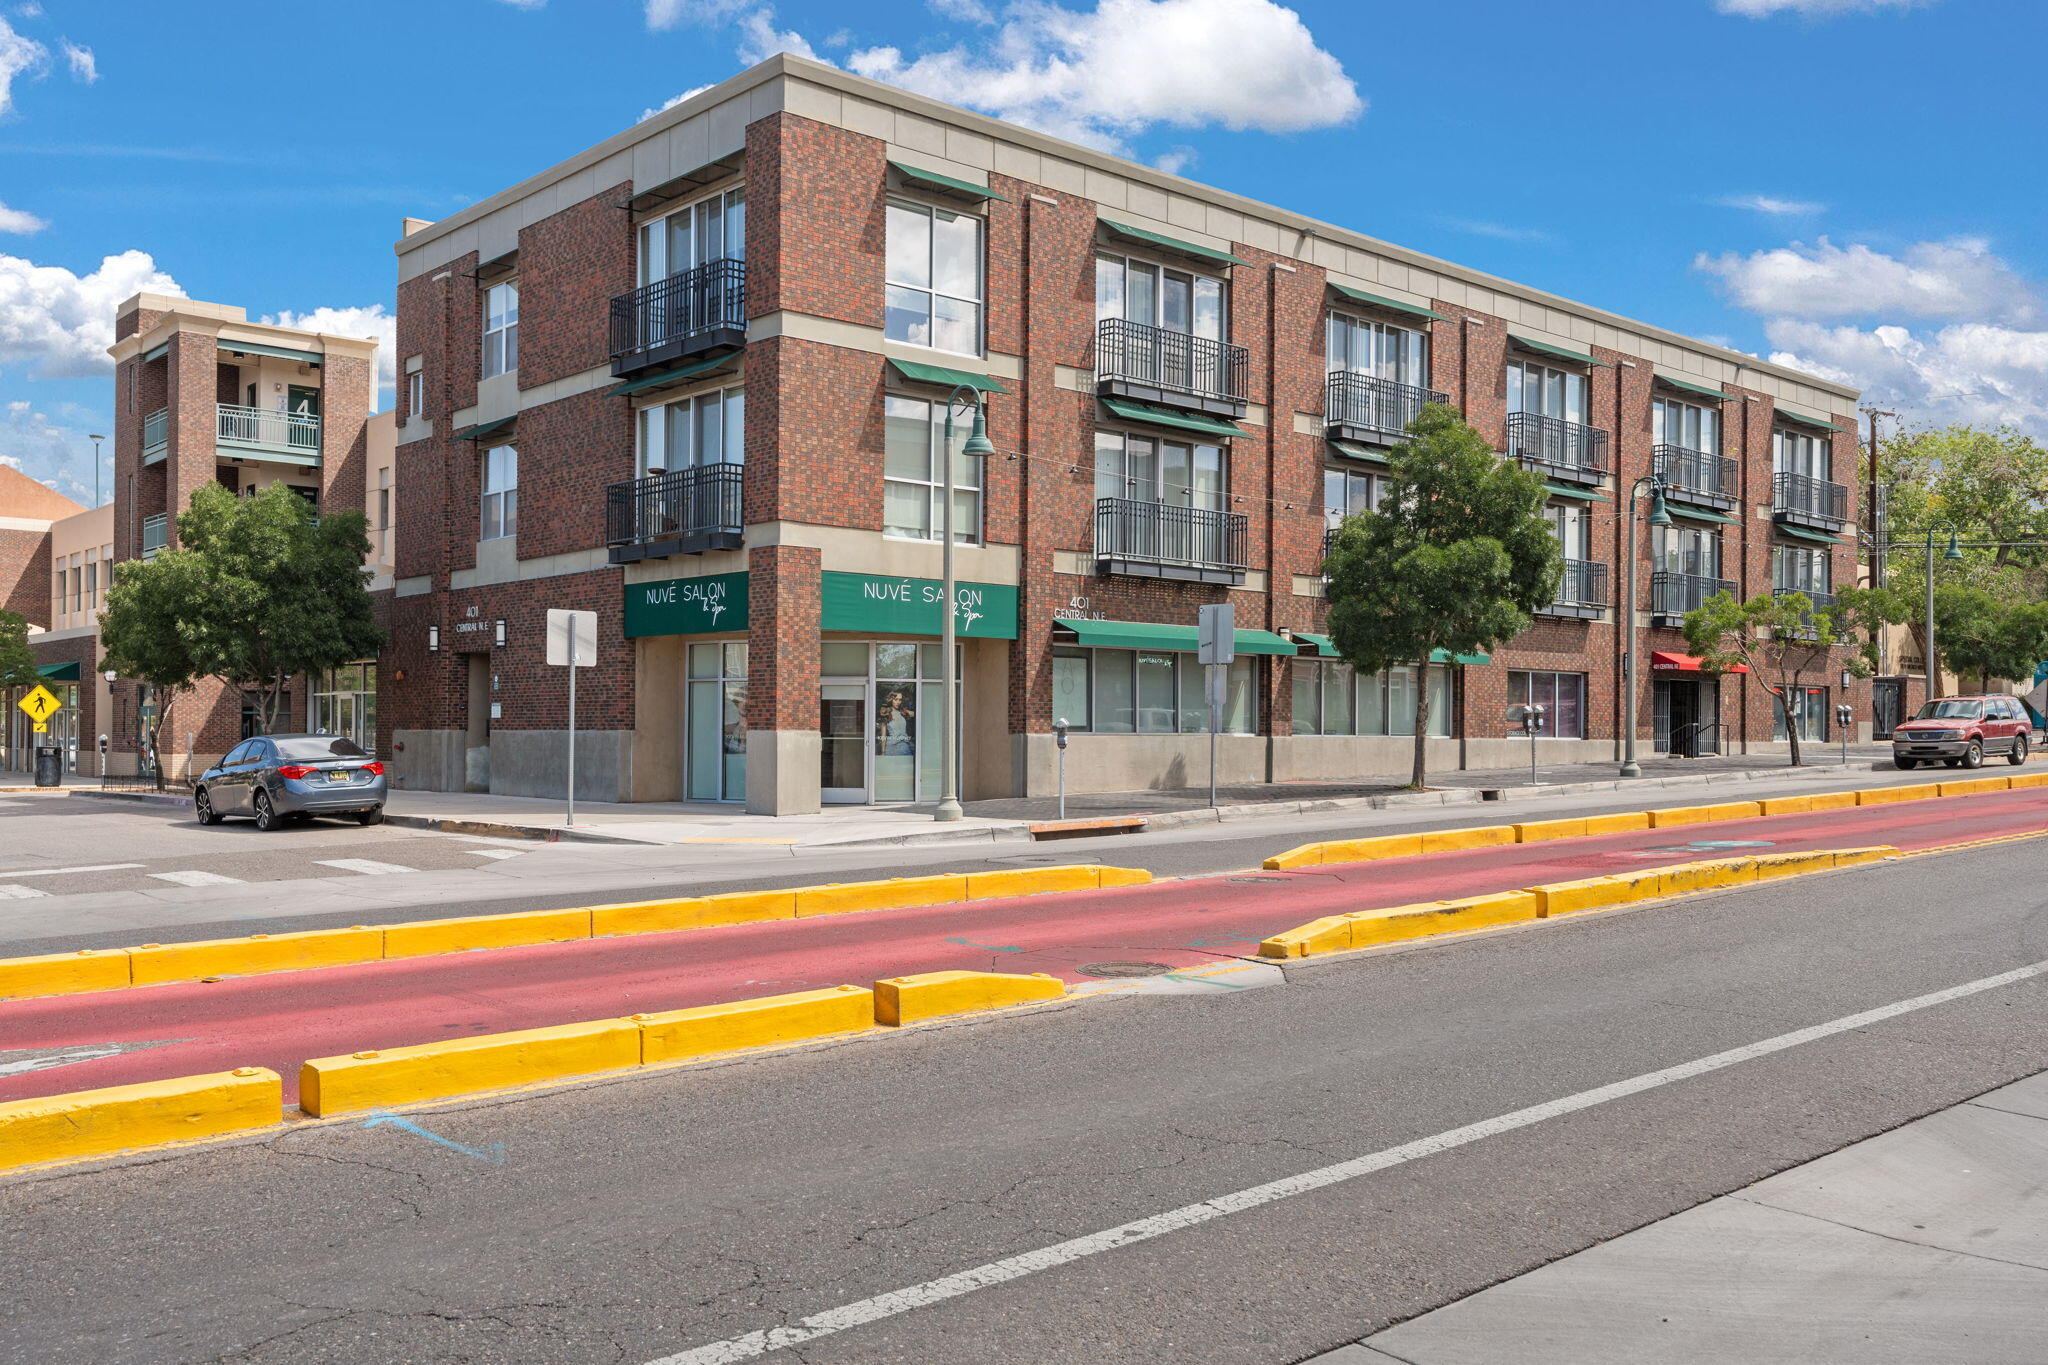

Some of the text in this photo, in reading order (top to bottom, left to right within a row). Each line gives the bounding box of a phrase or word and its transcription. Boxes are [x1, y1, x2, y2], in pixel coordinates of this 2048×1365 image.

[646, 581, 726, 605] NUVÉ SALON
[863, 579, 982, 606] NUVÉ SAON
[1070, 597, 1089, 611] 401
[466, 605, 479, 617] 401
[702, 595, 727, 627] & Spa
[952, 601, 984, 632] & Spa
[1054, 608, 1089, 620] CENTRAL
